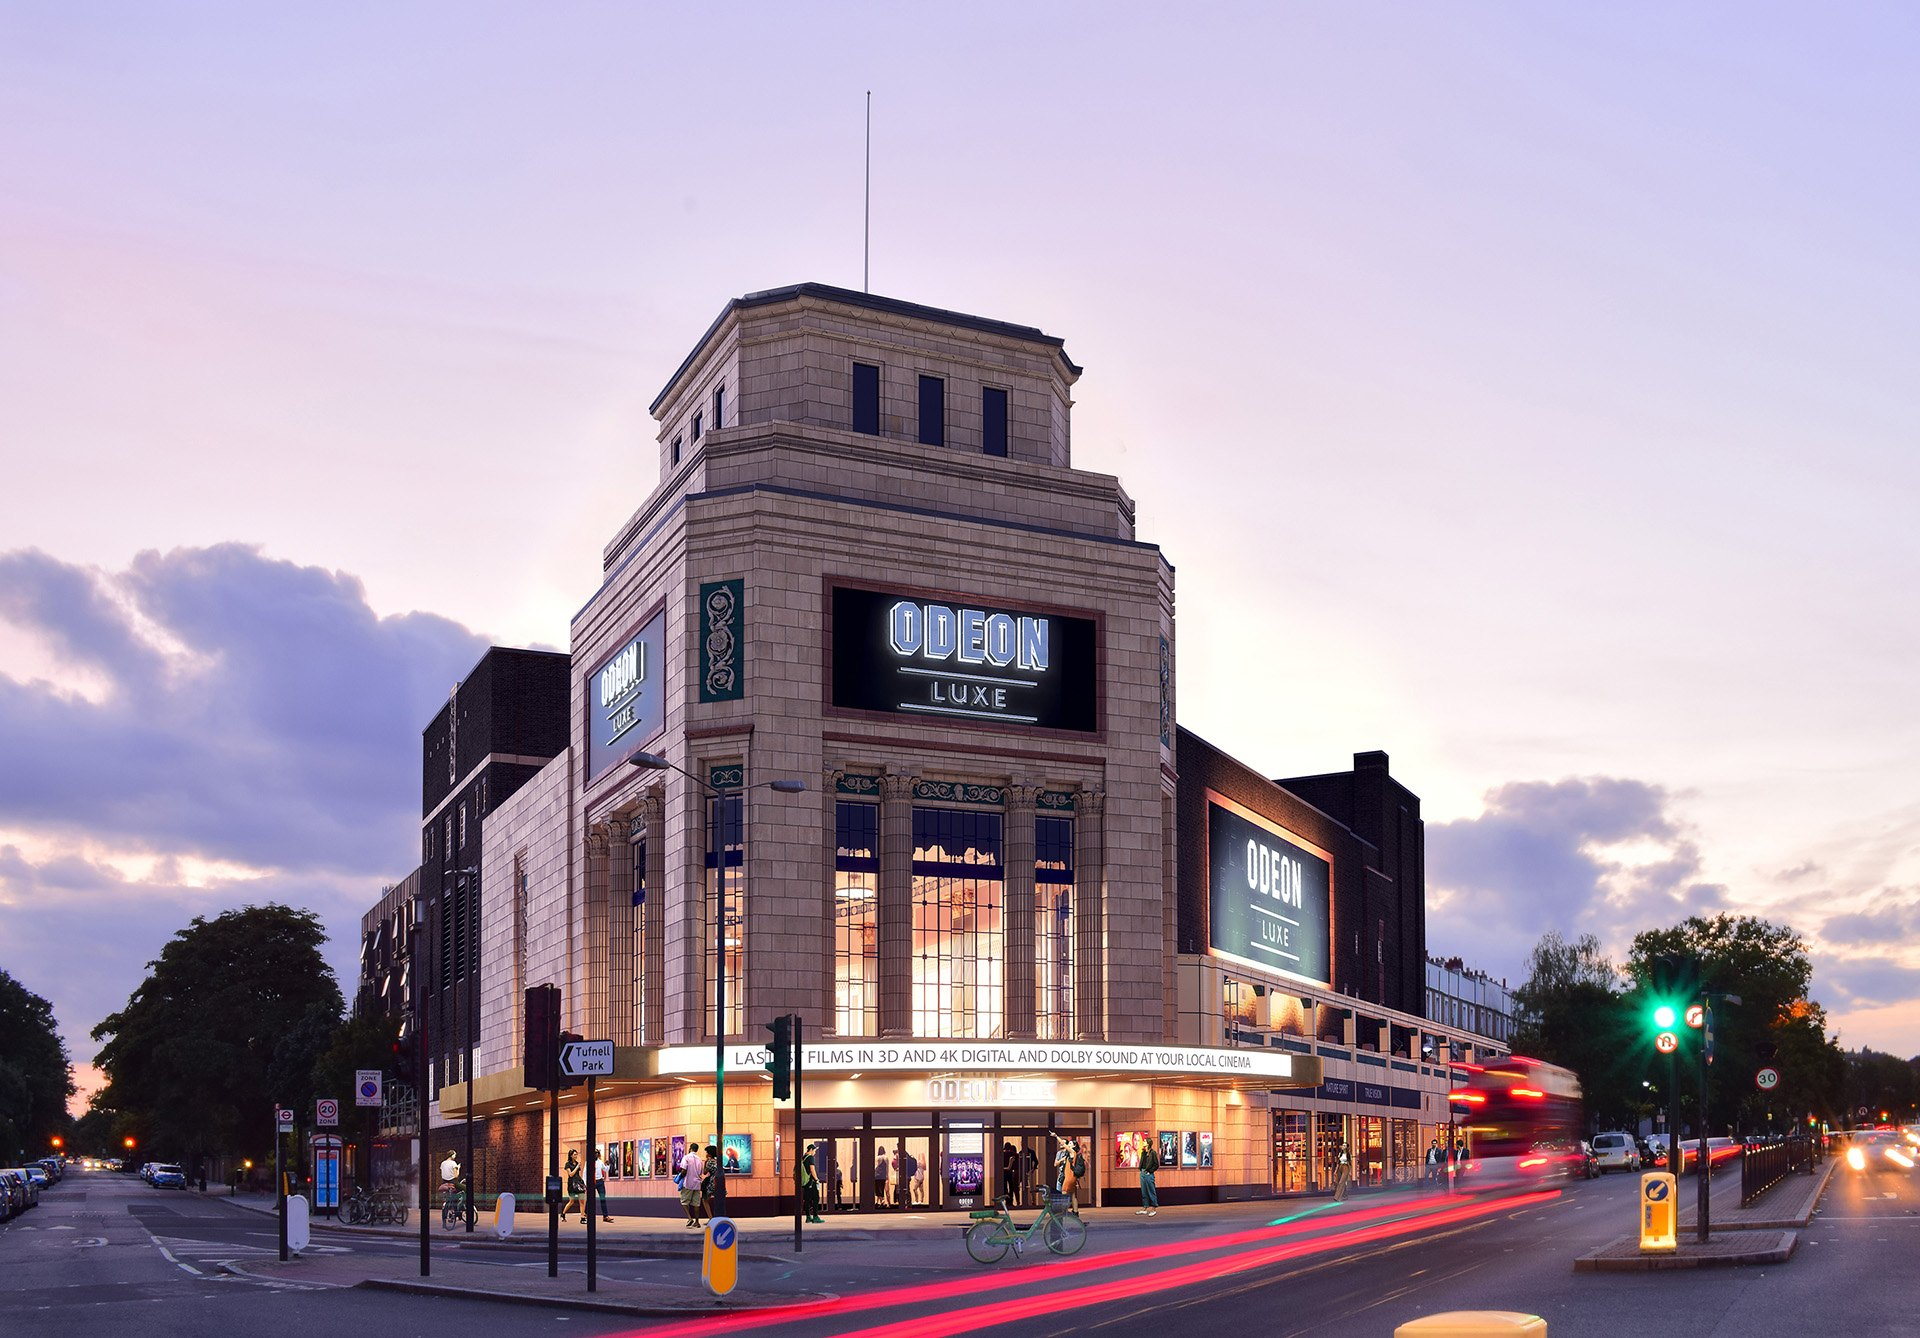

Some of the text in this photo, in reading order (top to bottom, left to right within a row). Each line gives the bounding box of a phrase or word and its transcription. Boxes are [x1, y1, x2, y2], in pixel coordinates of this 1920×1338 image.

[890, 601, 1049, 671] ODEON
[931, 681, 1007, 708] LUXE
[613, 706, 634, 732] LUXE
[1247, 839, 1301, 909] ODEON
[1262, 920, 1289, 947] LUXE
[576, 1046, 610, 1057] Tufnell
[808, 1050, 853, 1064] FILMS
[858, 1050, 873, 1063] IN
[878, 1050, 898, 1063] 3D
[903, 1050, 936, 1063] AND
[940, 1050, 958, 1063] 4K
[962, 1050, 1014, 1063] DIGITAL
[1018, 1050, 1047, 1063] AND
[1051, 1050, 1093, 1064] DOLBY
[1096, 1051, 1138, 1064] SOUND
[1141, 1052, 1153, 1065] AT
[1156, 1053, 1184, 1066] YOUR
[1187, 1054, 1217, 1067] LOCAL
[1219, 1055, 1251, 1068] CINEMA
[582, 1061, 604, 1071] Park
[1759, 1073, 1776, 1084] 30
[928, 1079, 998, 1102] ODEON
[321, 1105, 334, 1114] 20
